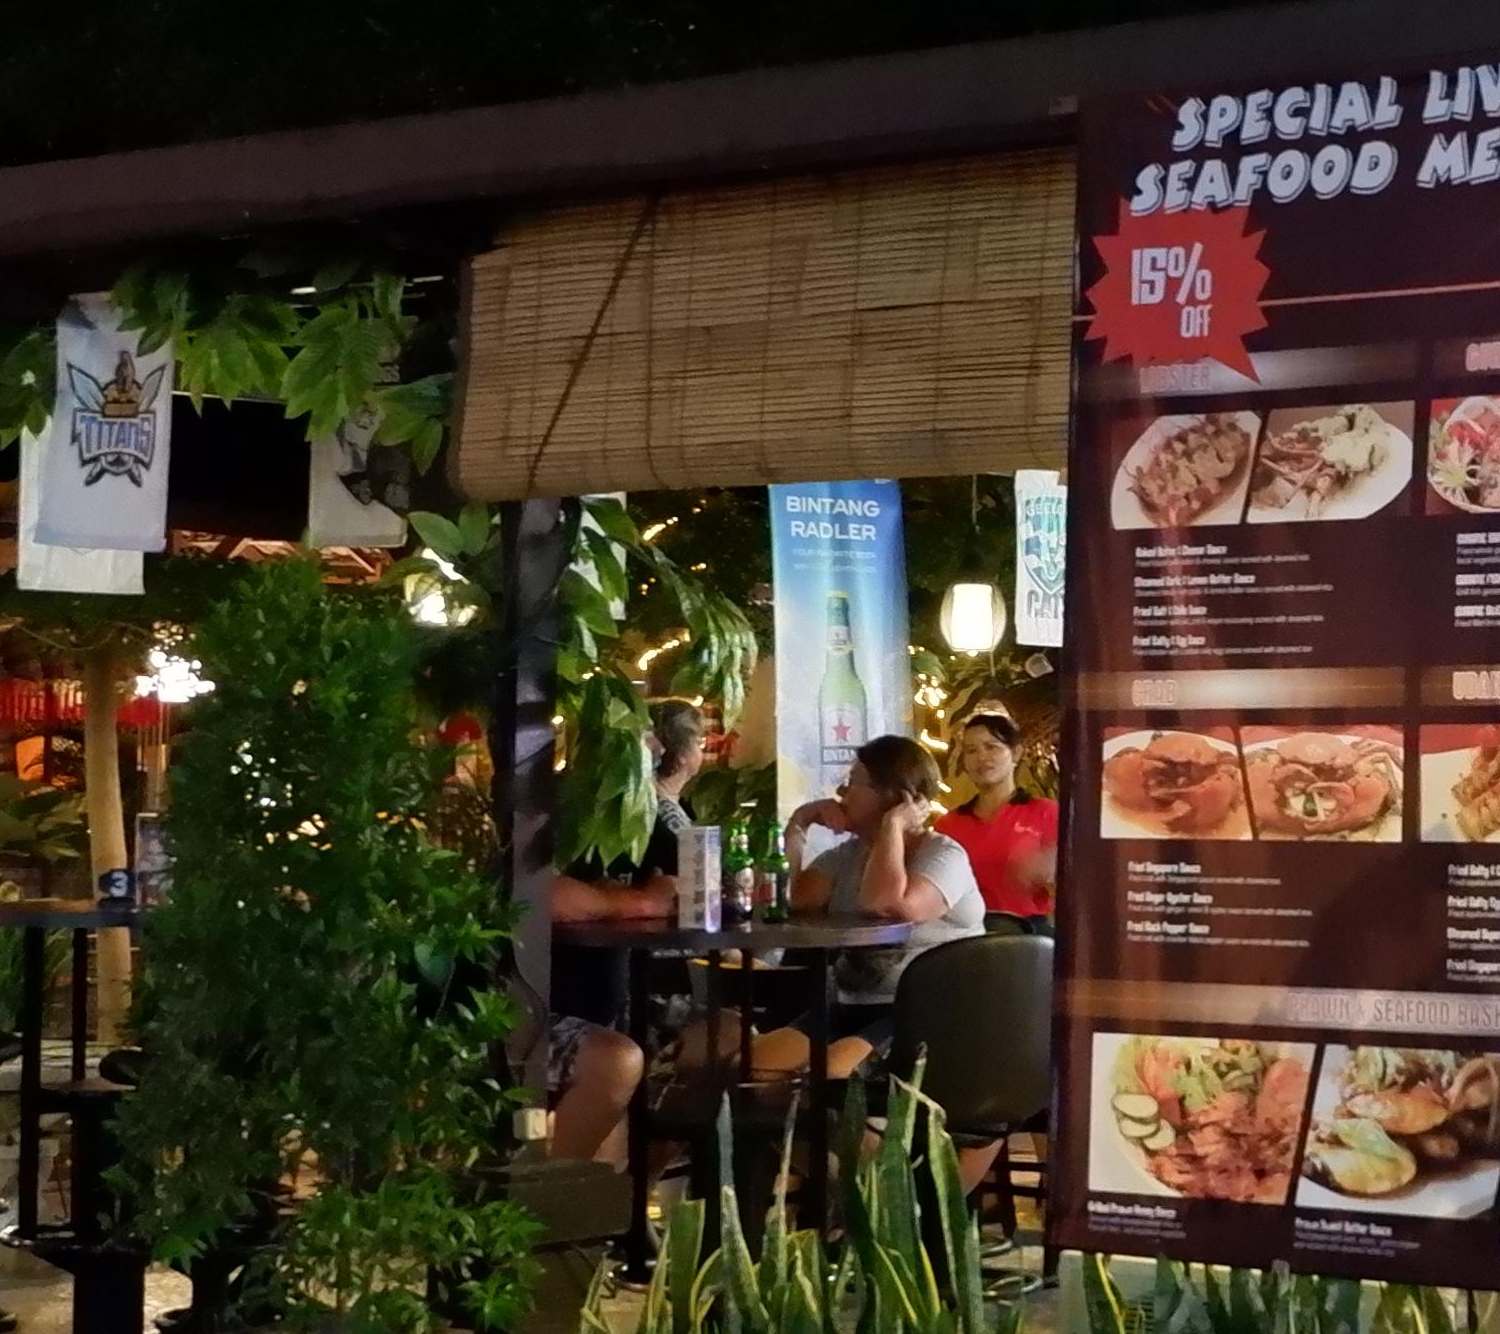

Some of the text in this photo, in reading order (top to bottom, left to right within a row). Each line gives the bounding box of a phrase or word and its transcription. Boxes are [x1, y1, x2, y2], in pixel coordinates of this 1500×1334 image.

[1172, 75, 1403, 153] SPECIAL
[1129, 139, 1402, 217] SEAFOOD
[1129, 243, 1213, 306] 15%
[1180, 305, 1211, 339] OFF
[786, 495, 881, 517] BINTANG
[790, 520, 877, 541] RADLER
[110, 870, 128, 898] 3
[1372, 996, 1449, 1027] SEAFOOD
